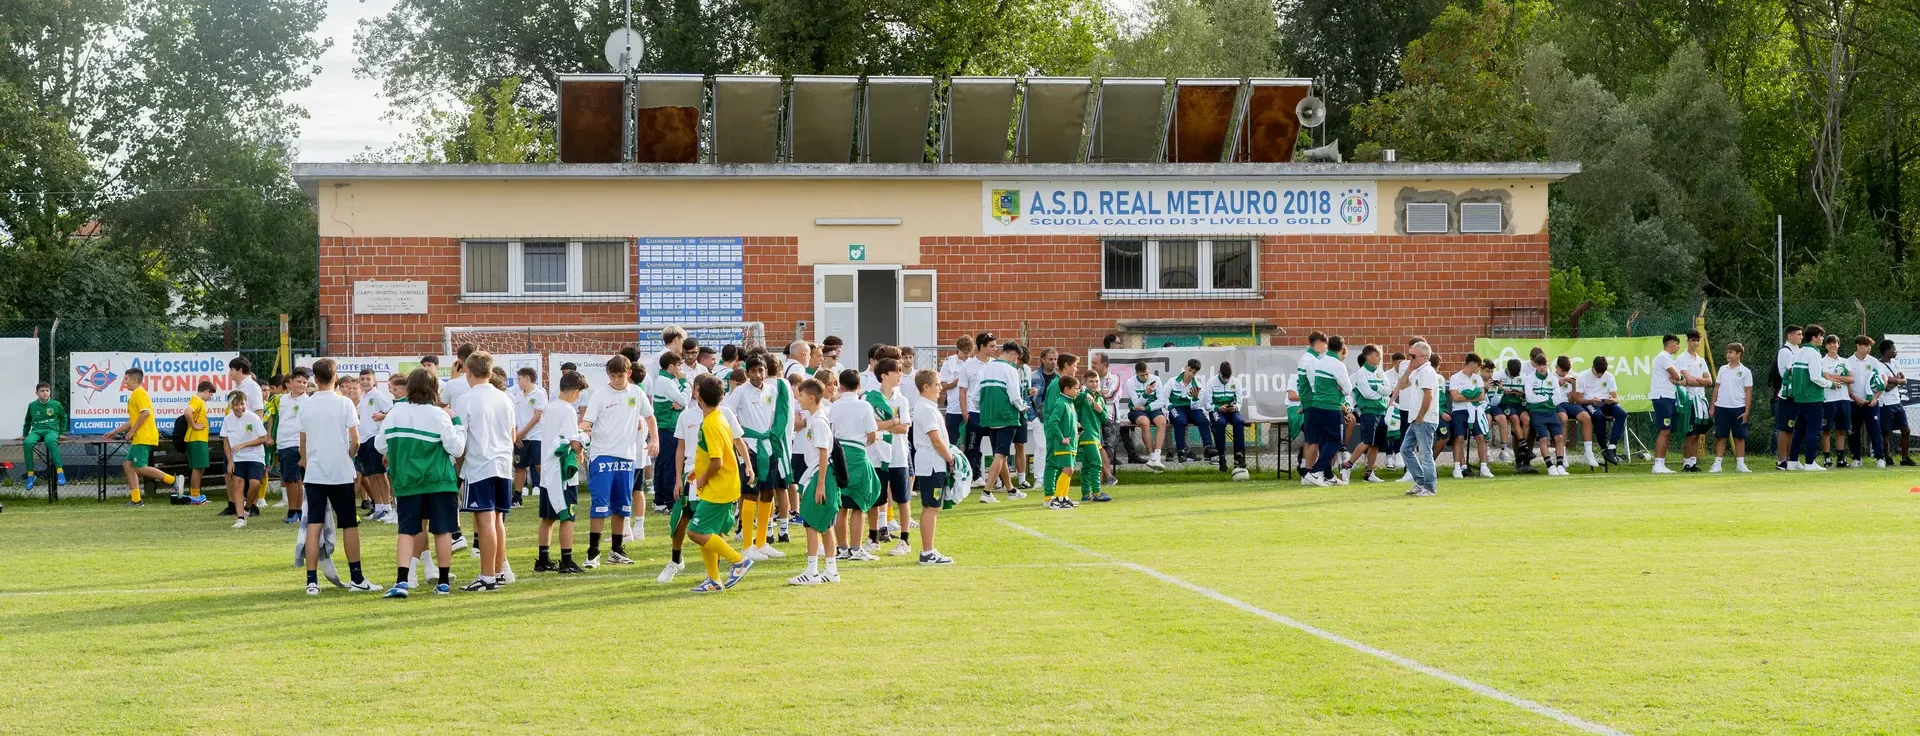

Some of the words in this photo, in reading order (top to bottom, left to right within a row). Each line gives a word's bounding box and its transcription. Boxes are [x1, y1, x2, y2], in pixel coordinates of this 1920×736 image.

[1030, 190, 1093, 215] A.S.D.
[1100, 190, 1161, 215] REAL
[1167, 190, 1278, 215] METAURO
[1284, 190, 1331, 215] 2018
[1347, 205, 1363, 213] FIGC
[1030, 218, 1099, 226] SCUOLA
[1104, 218, 1165, 226] CALCIO
[1210, 217, 1279, 225] LIVELLO
[1286, 217, 1331, 225] GOLD
[131, 357, 224, 373] Autoscuole
[336, 363, 390, 371] ROTERMICA
[1605, 356, 1653, 377] FAN
[74, 421, 113, 429] CALCINELLI
